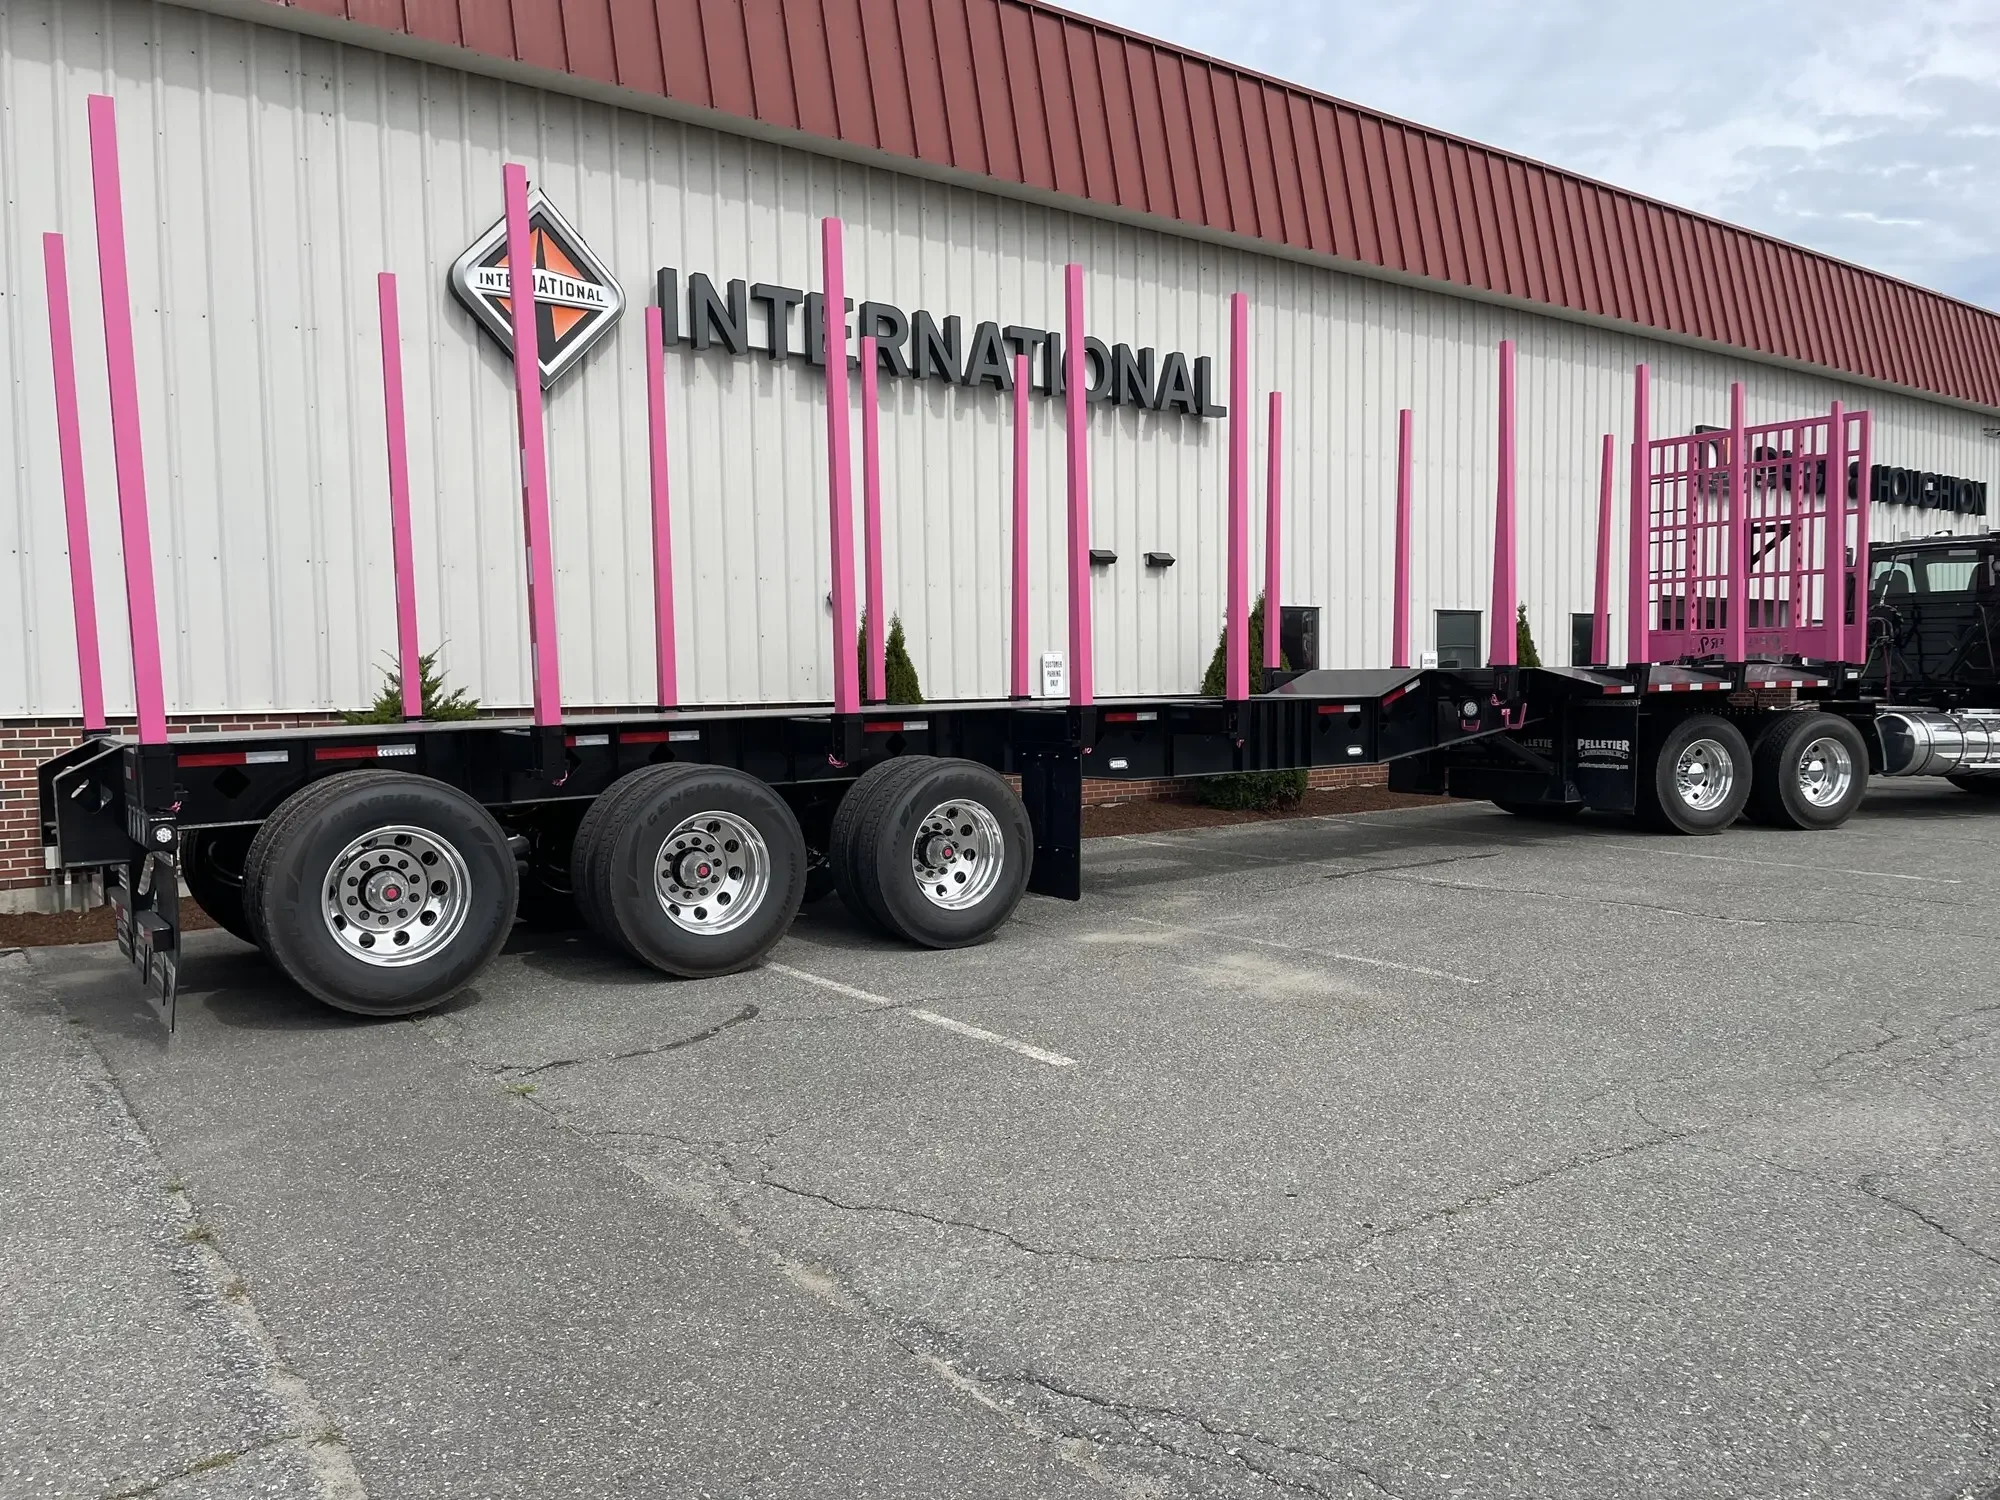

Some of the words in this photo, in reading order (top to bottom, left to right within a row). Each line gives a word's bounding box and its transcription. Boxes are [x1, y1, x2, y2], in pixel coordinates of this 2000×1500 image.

[658, 267, 1227, 417] INTERNATIONAL
[1871, 464, 1987, 516] HOUGHTON
[1577, 738, 1630, 752] PELLETIER
